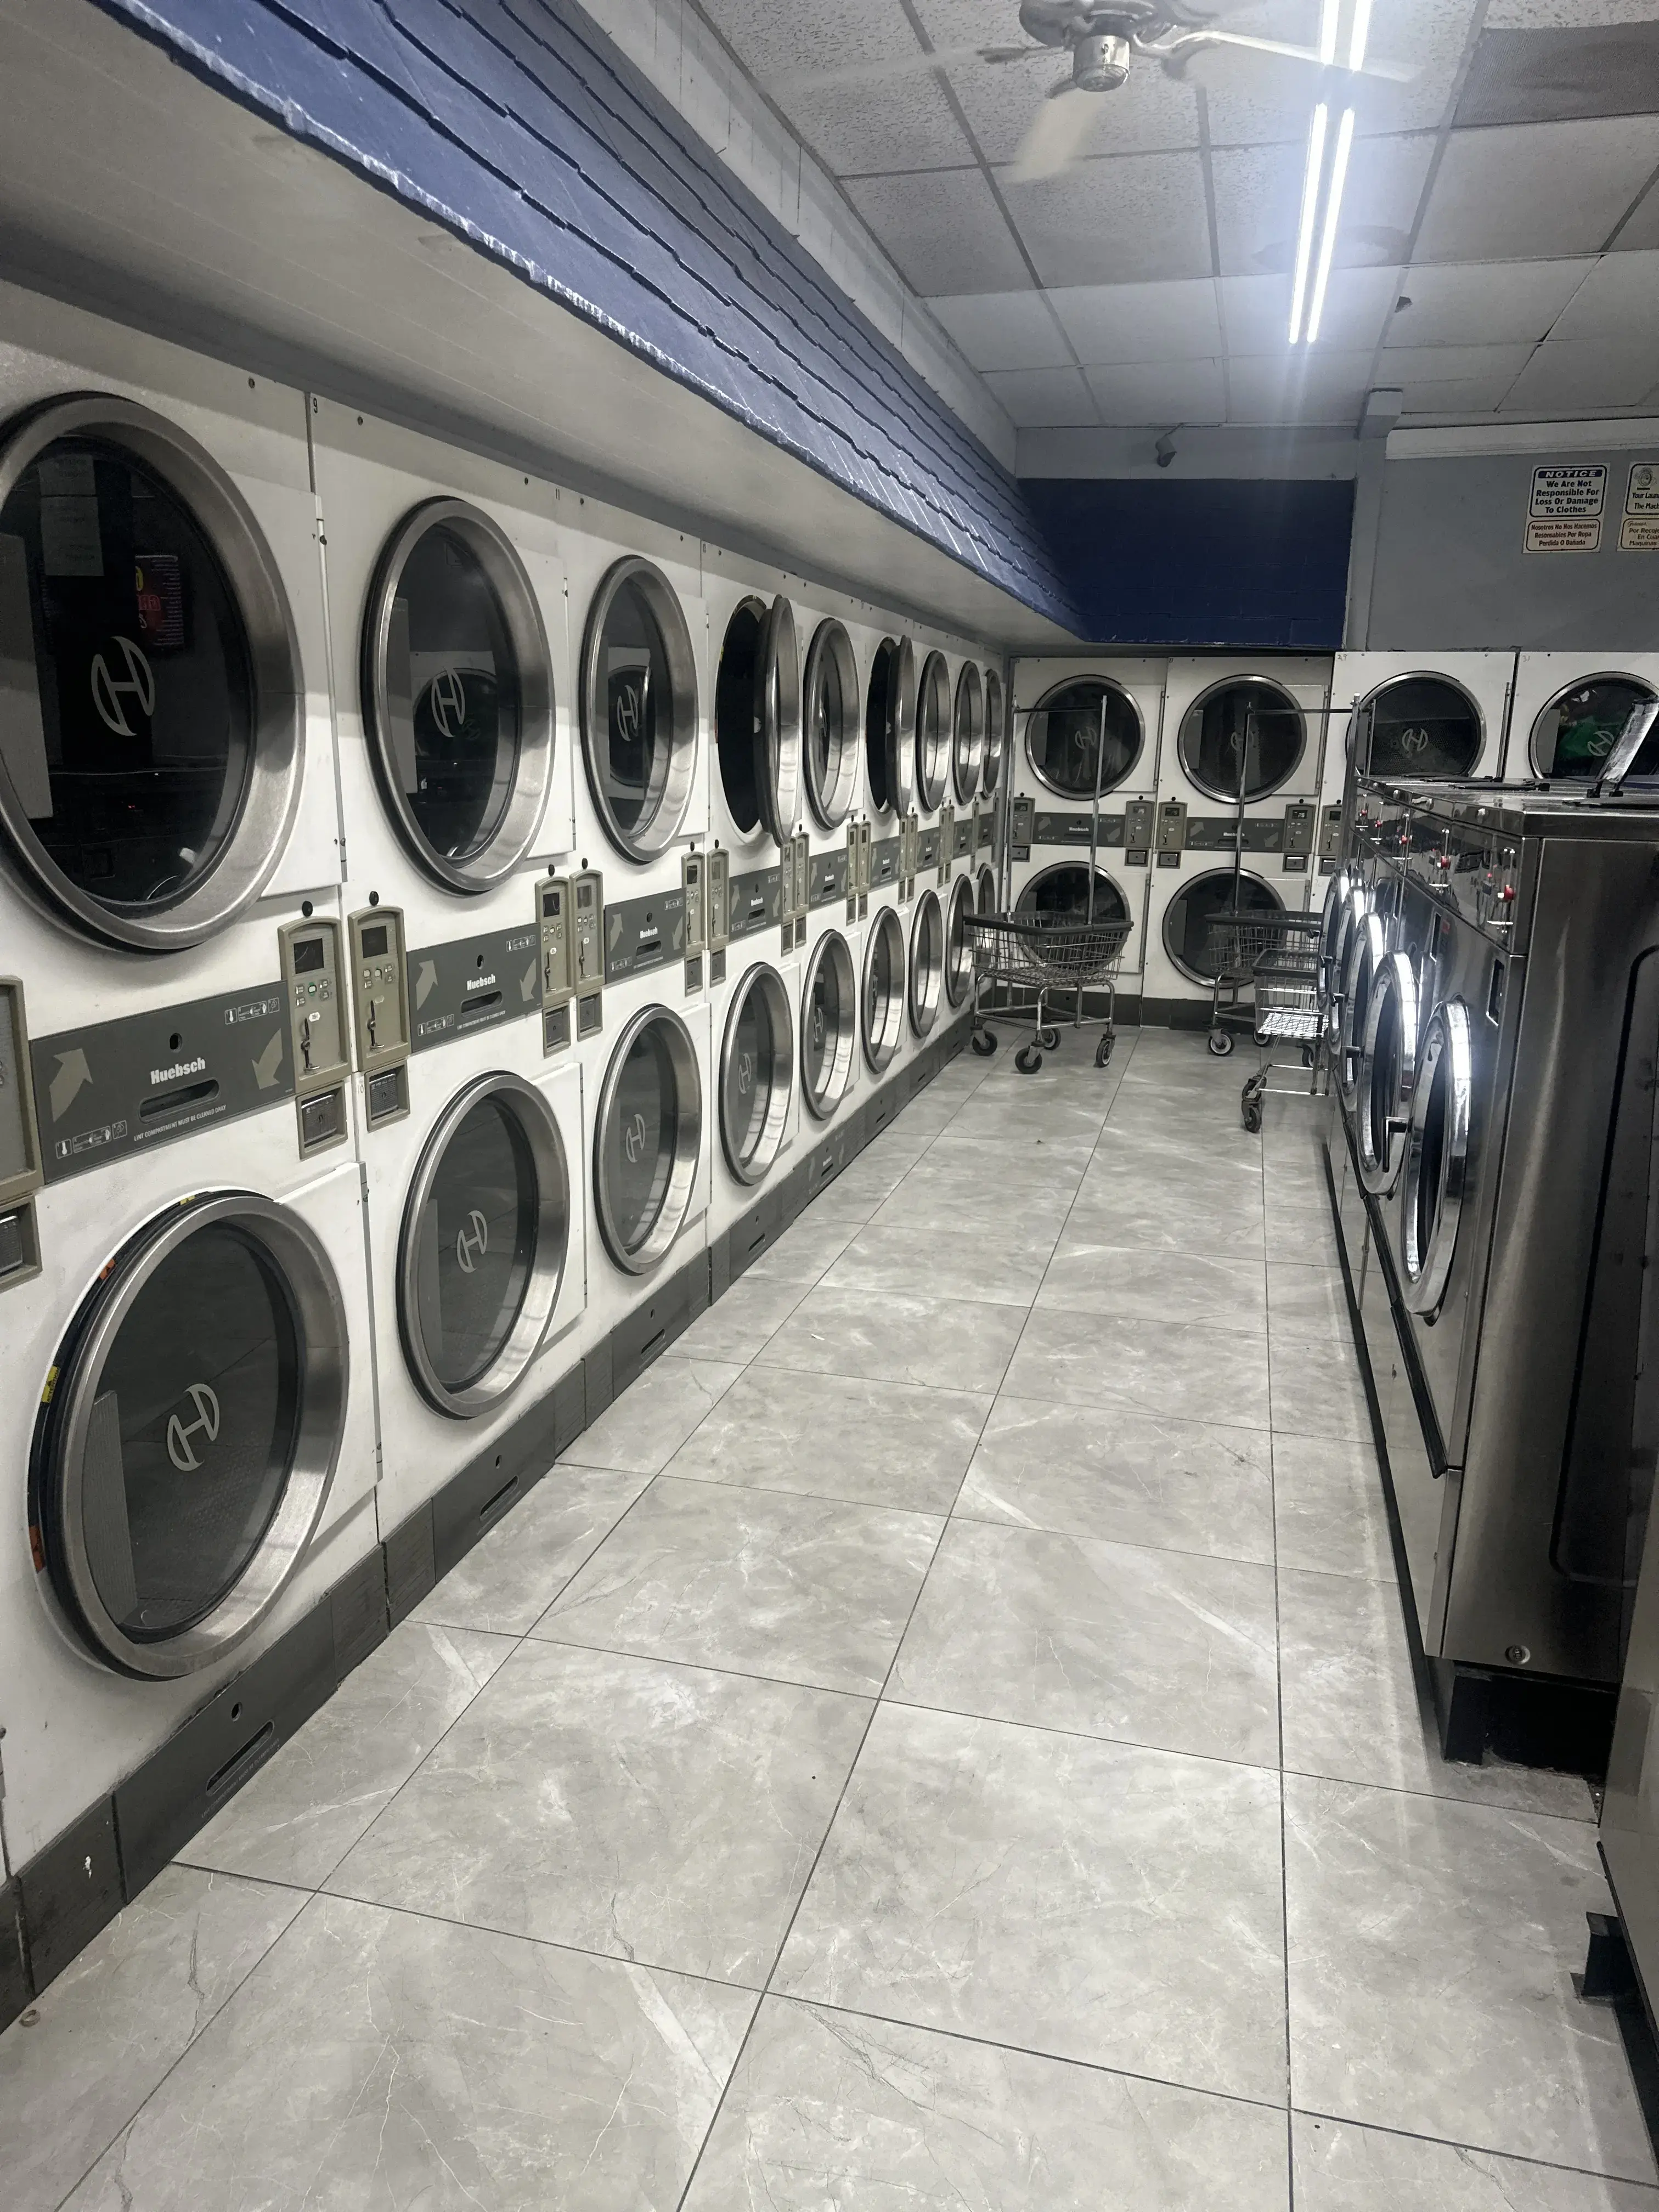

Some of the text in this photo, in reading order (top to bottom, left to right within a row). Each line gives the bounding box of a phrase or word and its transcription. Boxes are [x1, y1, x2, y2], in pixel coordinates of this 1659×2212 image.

[313, 397, 318, 414] 9
[1536, 489, 1584, 498] Responsible
[466, 973, 496, 991] Huebsch
[150, 1057, 206, 1085] Huebsch
[133, 1133, 144, 1142] LINT
[144, 1121, 178, 1138] COMPARTMENT
[178, 1117, 190, 1126] MUST
[196, 1109, 215, 1120] CLEANED
[215, 1104, 227, 1114] DAILY
